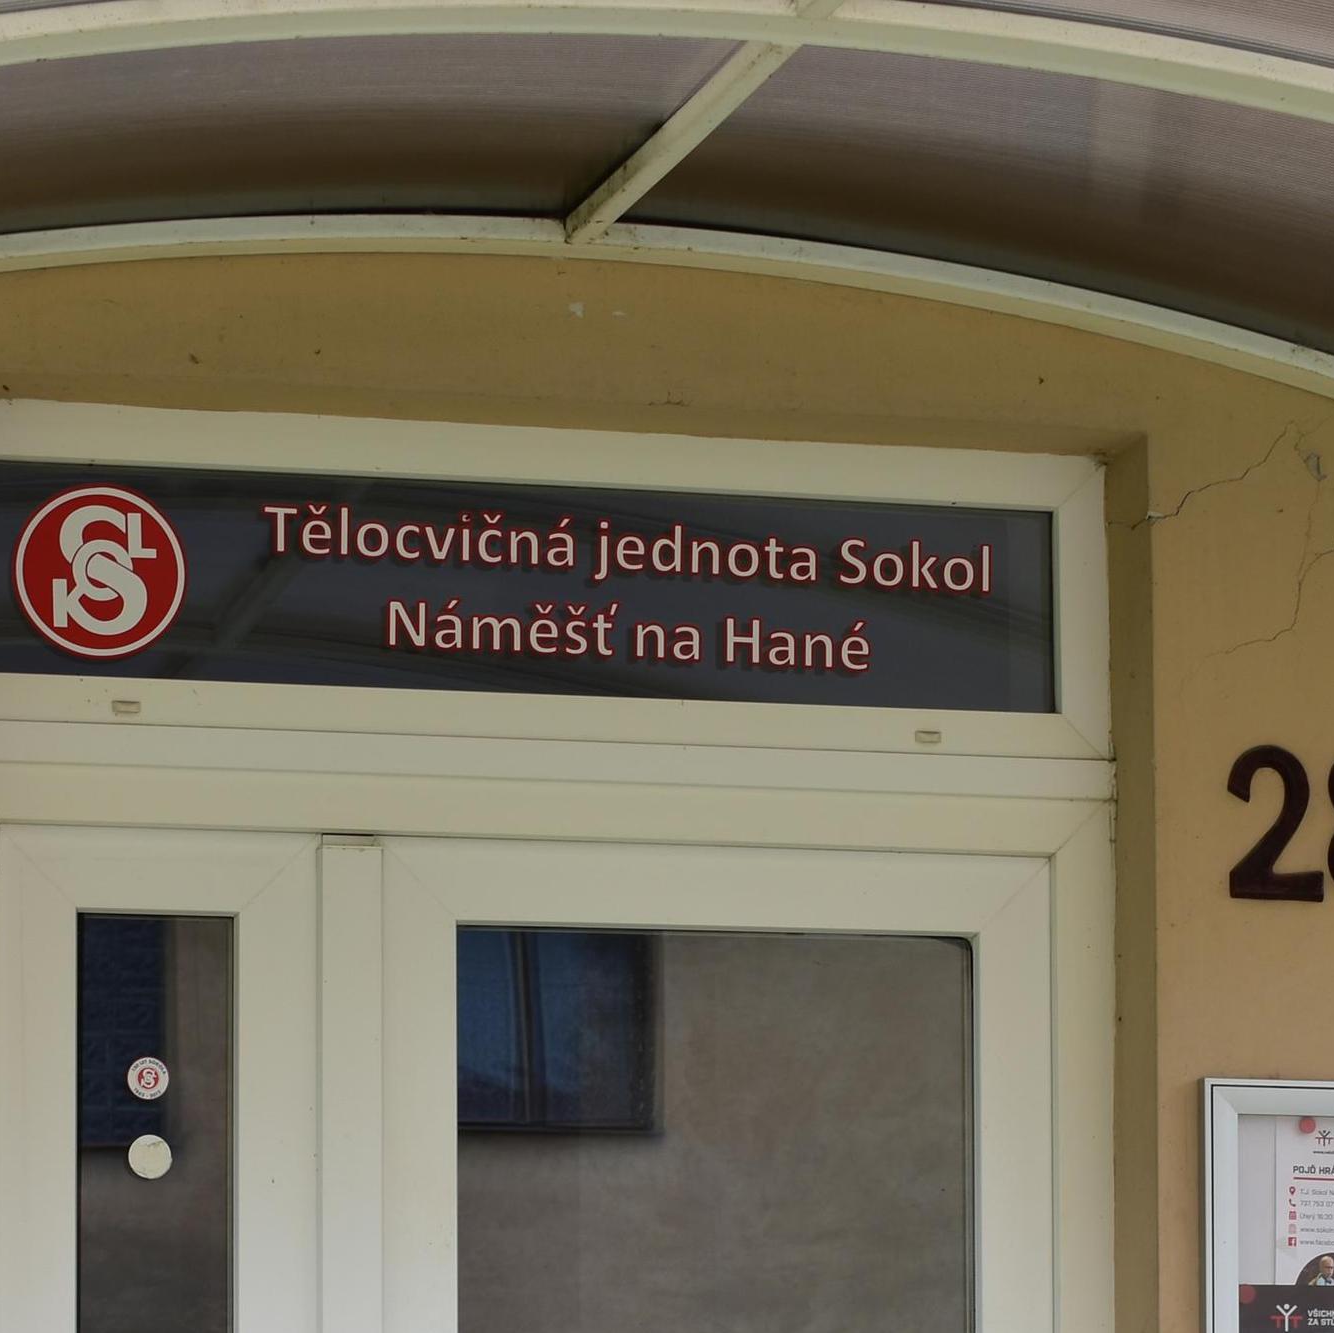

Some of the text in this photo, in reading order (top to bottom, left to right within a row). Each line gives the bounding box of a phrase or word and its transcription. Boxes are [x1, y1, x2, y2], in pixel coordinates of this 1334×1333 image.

[263, 503, 991, 593] Tělocvičná jednota Sokol
[387, 599, 871, 672] Náměšť na Hané
[1293, 1165, 1316, 1174] POJĎ
